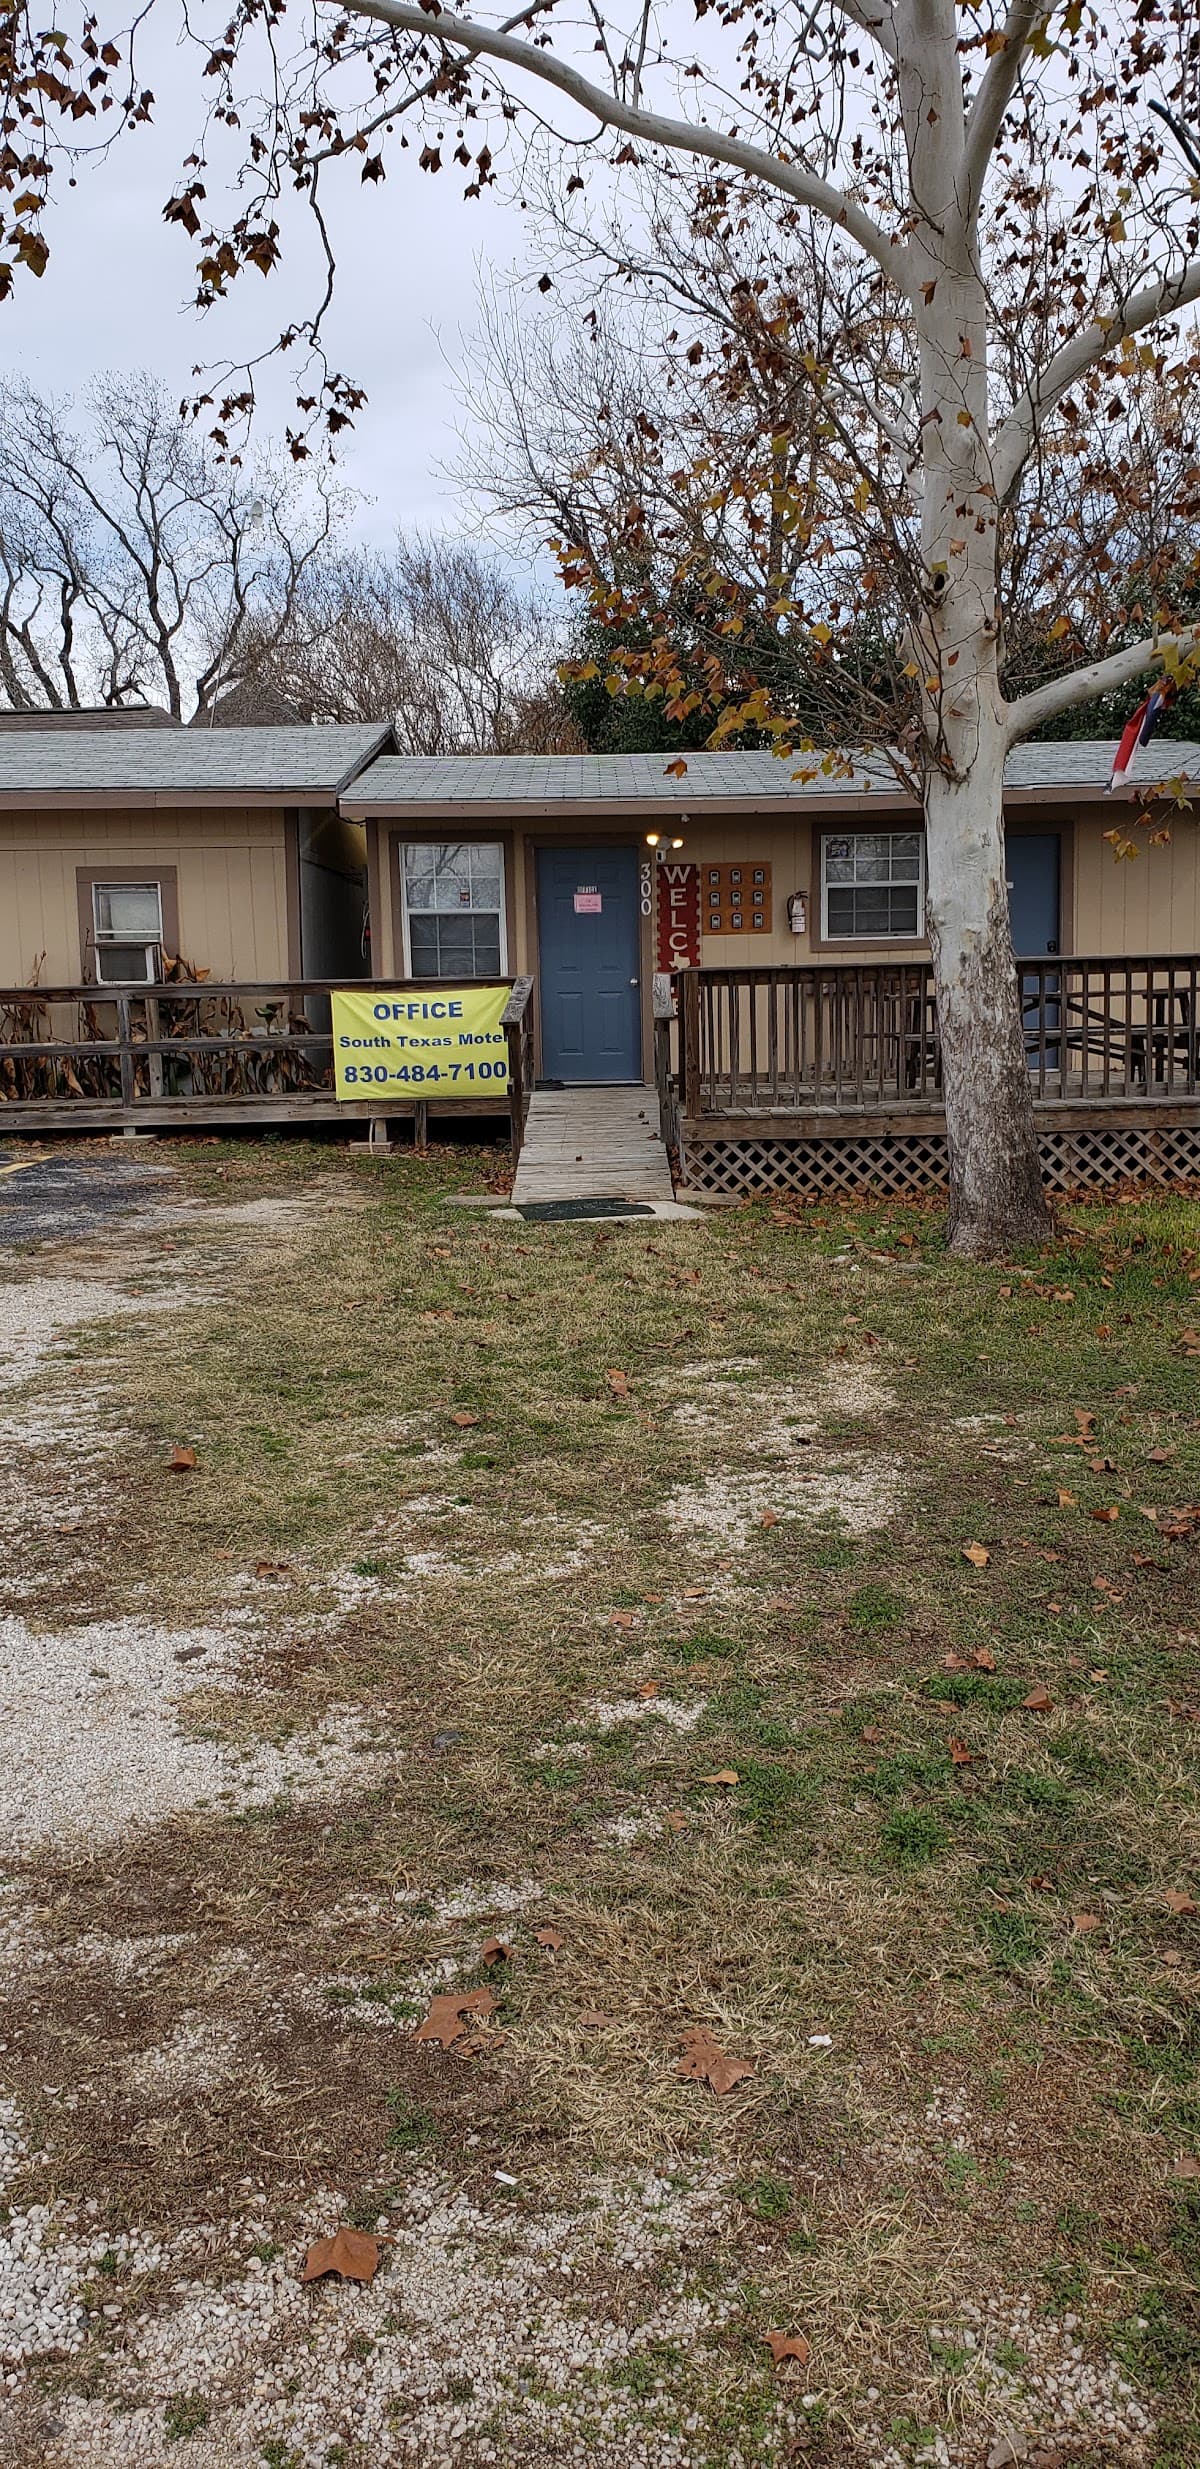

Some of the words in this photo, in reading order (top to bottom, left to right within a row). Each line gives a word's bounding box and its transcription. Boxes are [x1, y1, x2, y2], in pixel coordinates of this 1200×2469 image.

[640, 863, 652, 915] 300
[373, 1001, 463, 1021] OFFICE
[339, 1036, 391, 1048] South
[397, 1036, 452, 1048] Texas
[458, 1032, 508, 1046] Motel
[344, 1061, 507, 1083] 830-484-7100
